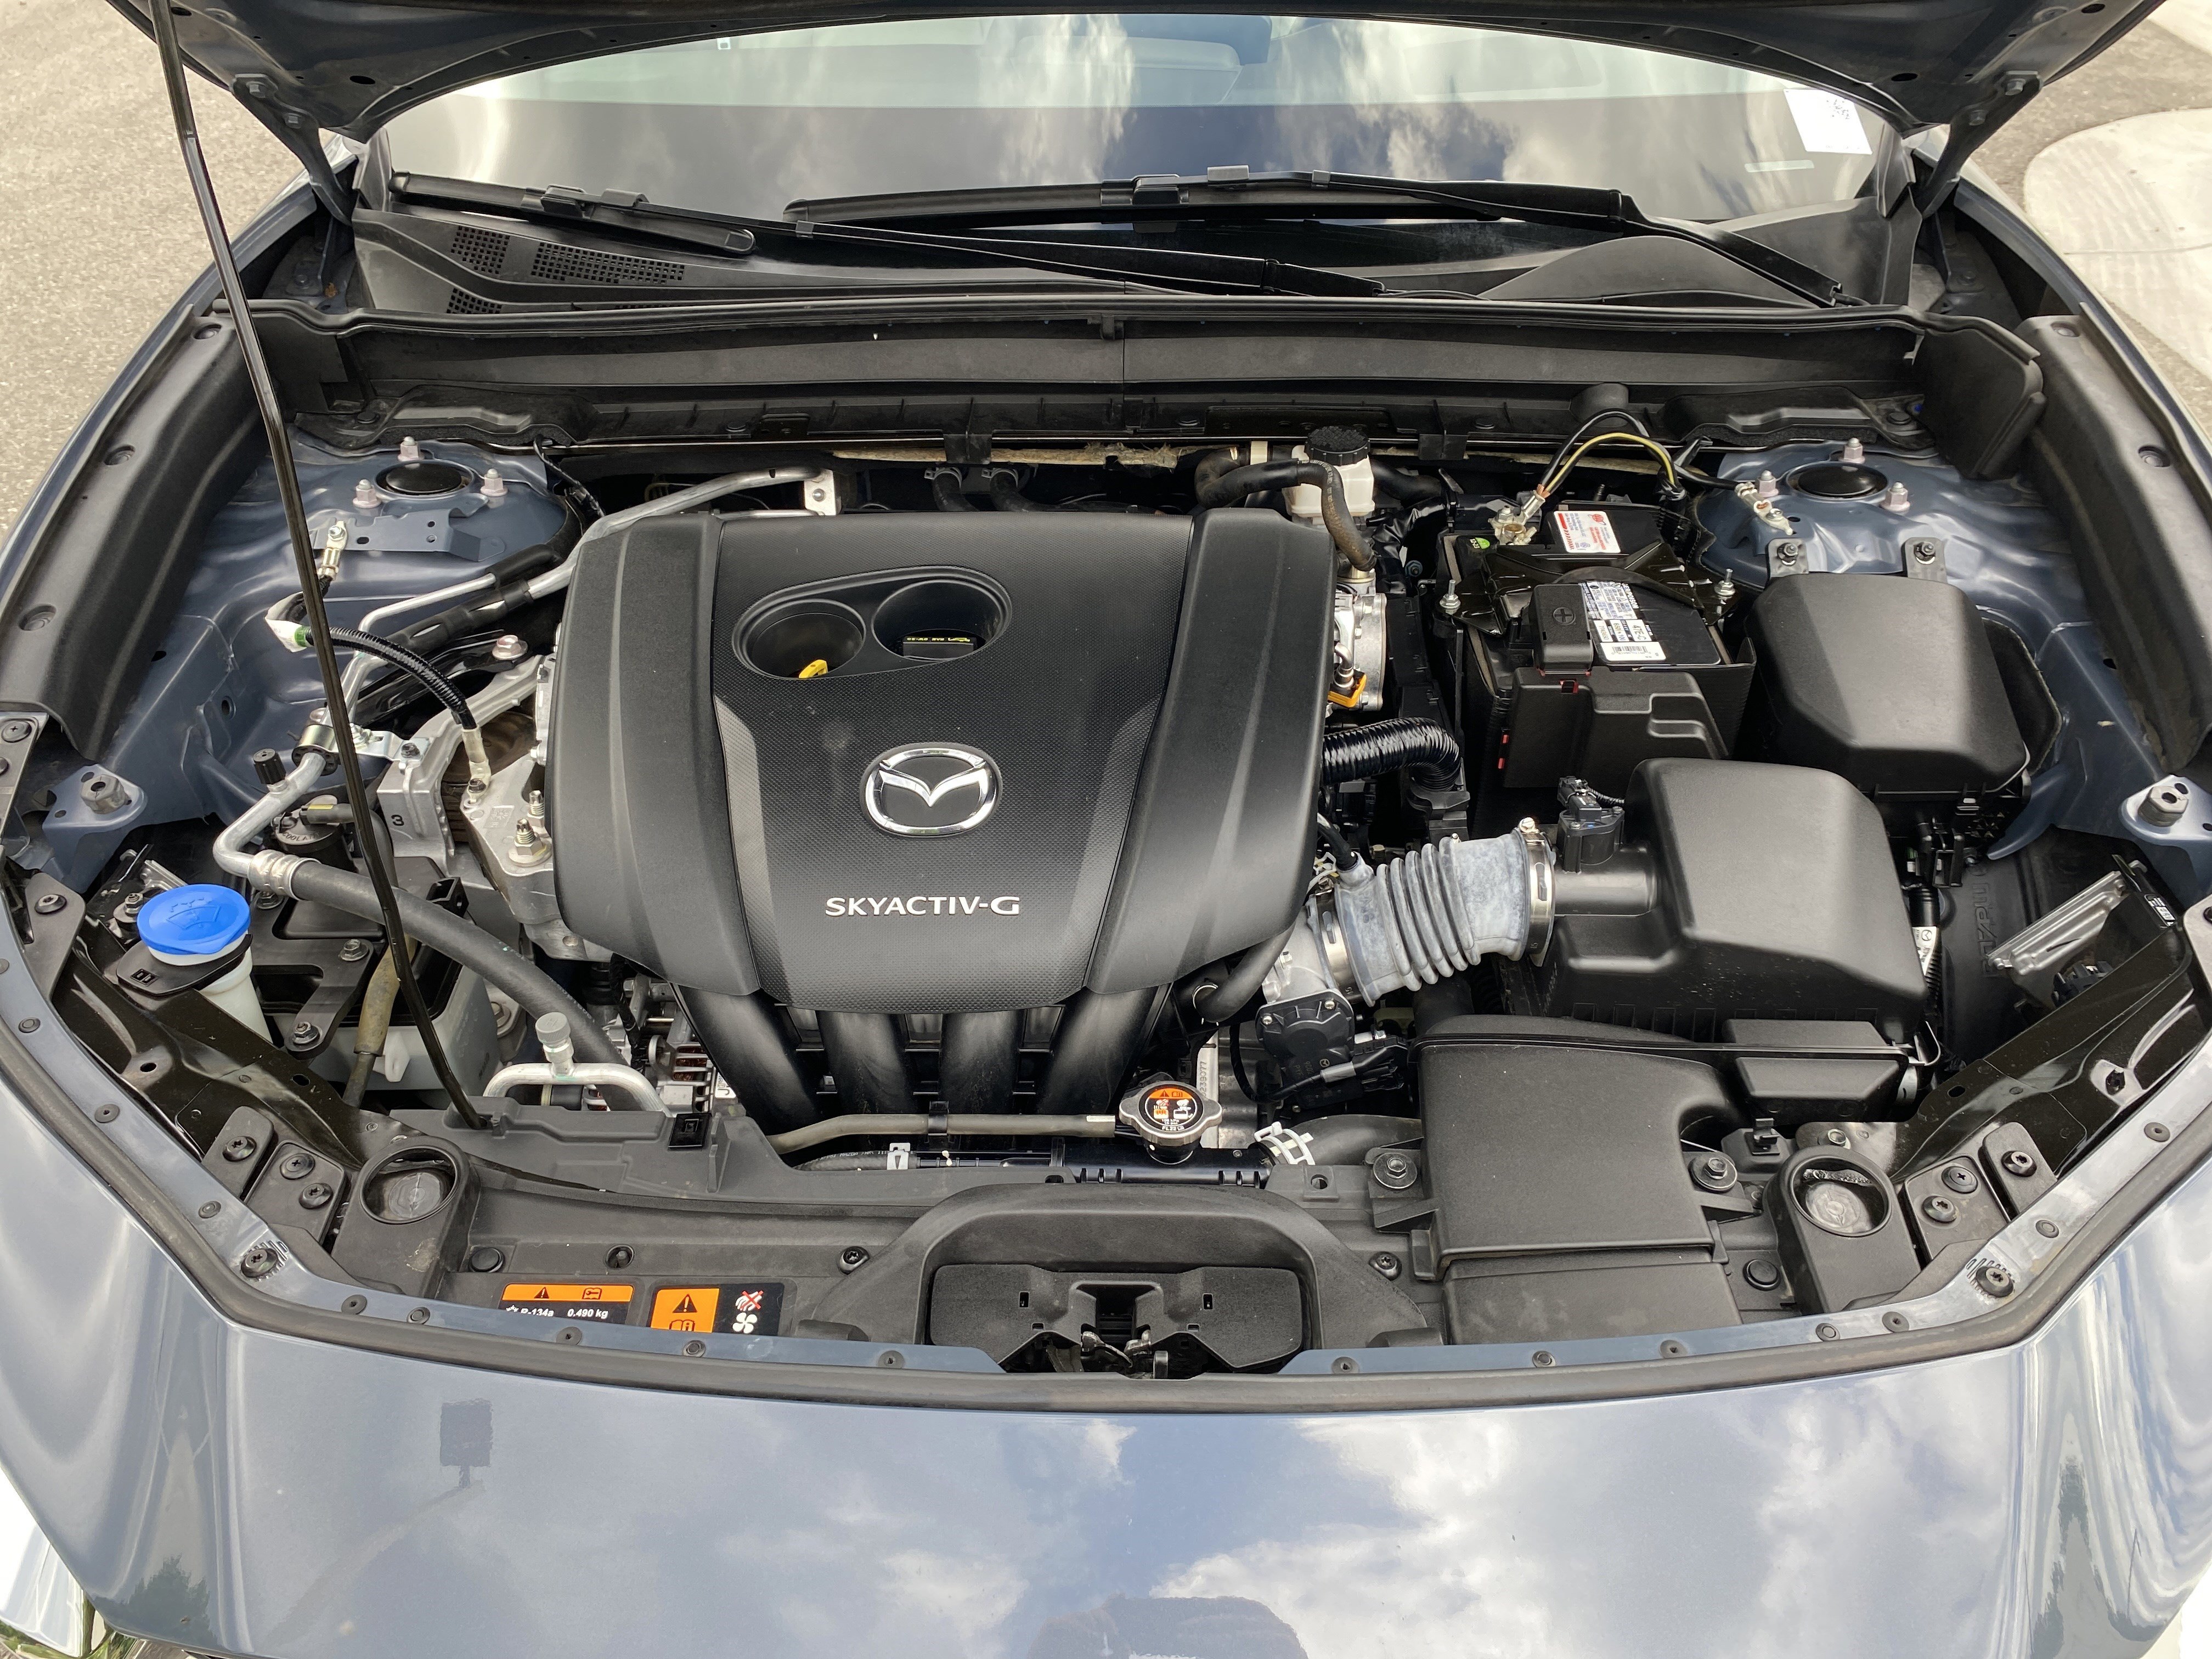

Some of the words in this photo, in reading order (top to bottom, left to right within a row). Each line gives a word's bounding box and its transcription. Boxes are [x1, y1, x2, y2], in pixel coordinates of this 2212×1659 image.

[391, 815, 404, 826] 3
[825, 896, 1020, 916] SKYACTIV-G
[567, 1308, 595, 1318] 0.490
[595, 1309, 609, 1319] kg
